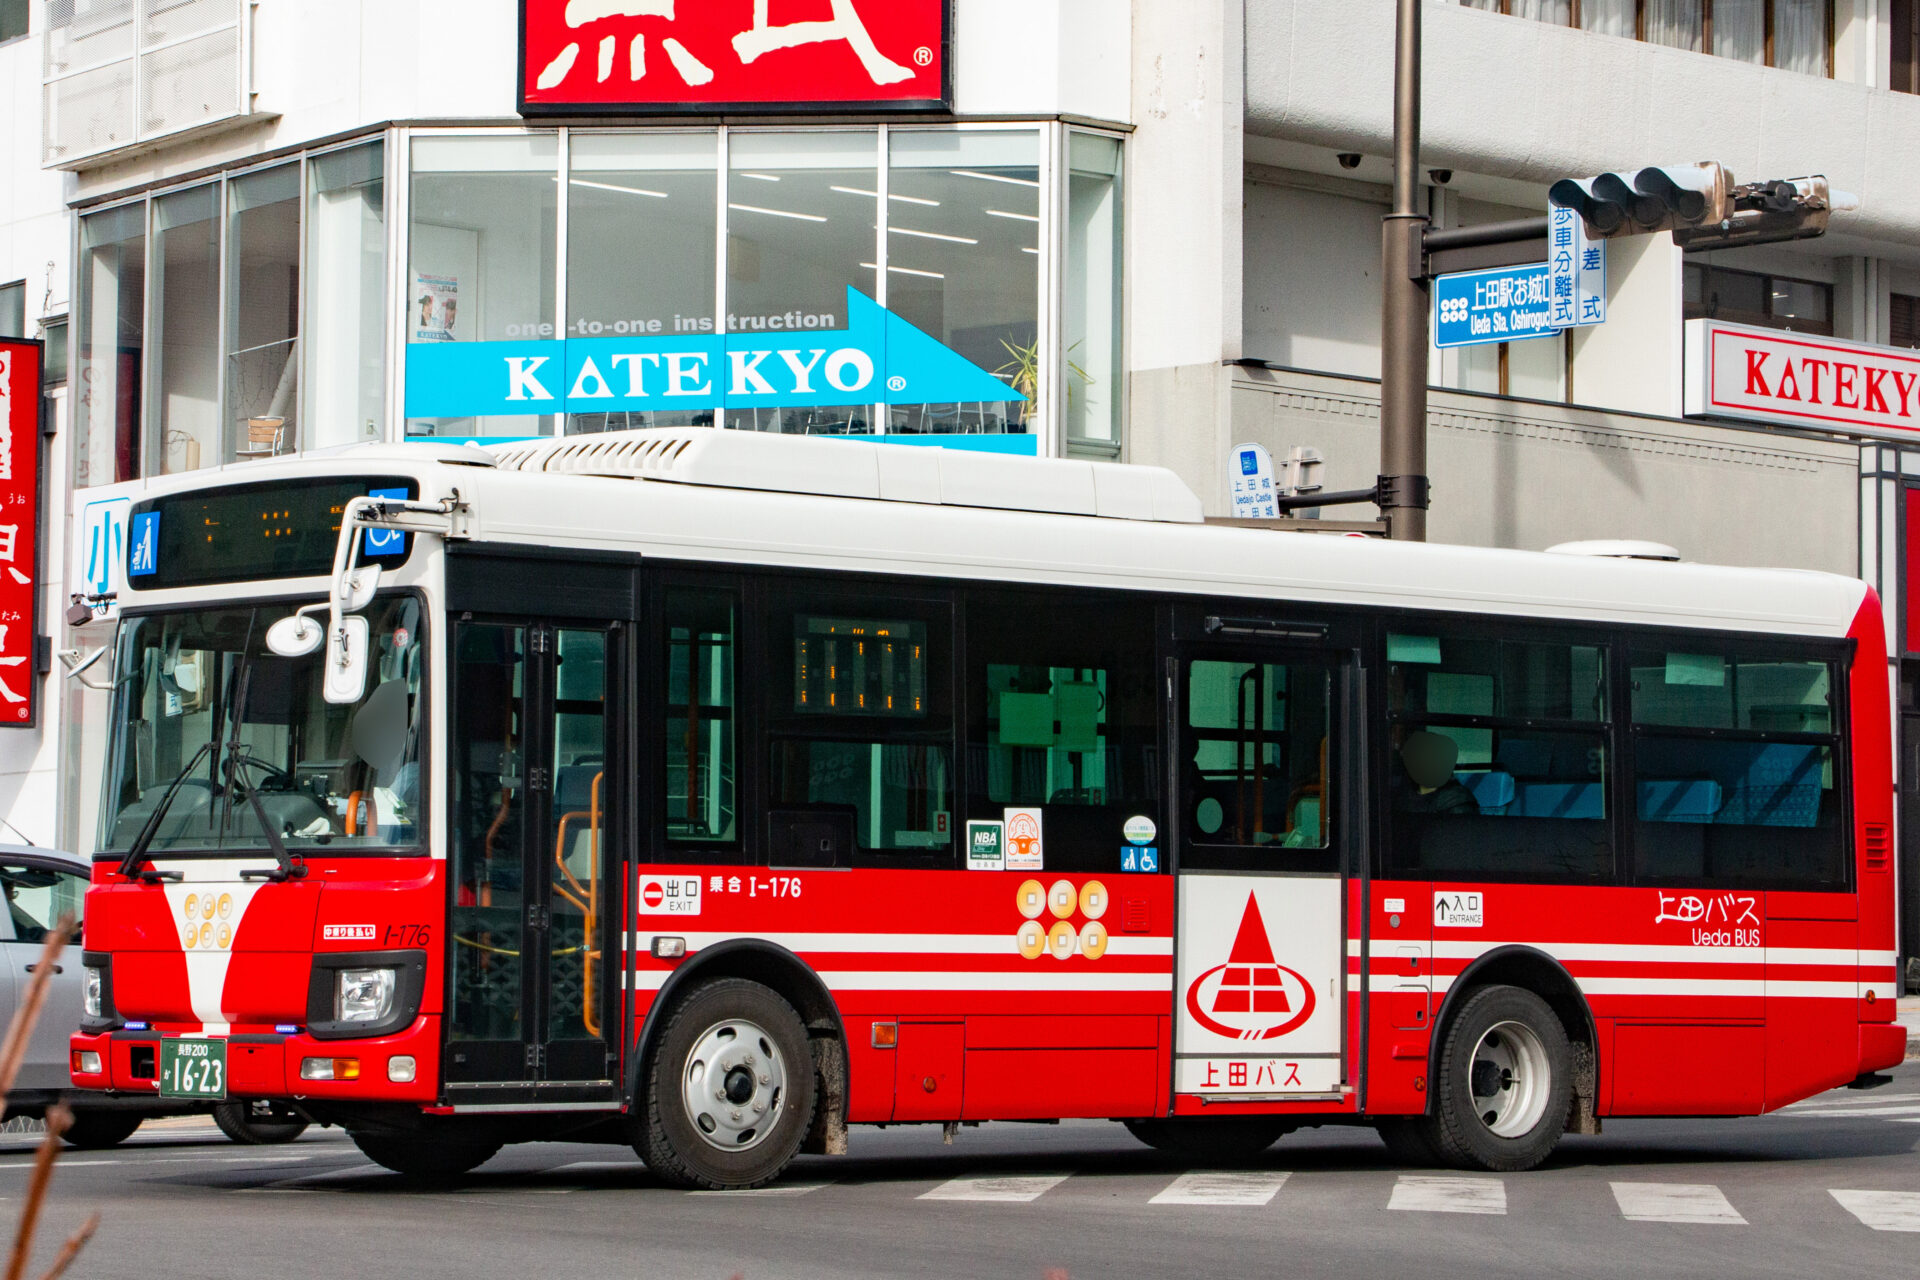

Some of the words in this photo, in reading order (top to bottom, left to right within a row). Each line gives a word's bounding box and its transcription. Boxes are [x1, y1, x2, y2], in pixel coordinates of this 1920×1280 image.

[1554, 207, 1573, 321] 歩車分離式
[1582, 248, 1601, 319] 差式
[505, 315, 662, 337] one-to-one
[674, 311, 836, 332] instruction
[1471, 313, 1491, 335] Ueda
[1493, 312, 1509, 333] Sta.
[1510, 309, 1550, 332] Oshiroguc
[504, 348, 874, 401] KATEKYO
[1744, 349, 1920, 418] KATEKY
[8, 493, 26, 505] うお
[974, 831, 997, 846] NBA
[666, 879, 698, 898] 出口
[749, 876, 802, 898] I-176
[669, 901, 694, 911] EXIT
[1453, 895, 1478, 911] 入口
[1655, 890, 1760, 926] 上田バス
[1449, 914, 1482, 924] ENTRANCE
[383, 924, 432, 947] I-176
[1692, 927, 1731, 946] Ueda
[1734, 928, 1760, 947] BUS
[1199, 1060, 1302, 1088] 上田バス
